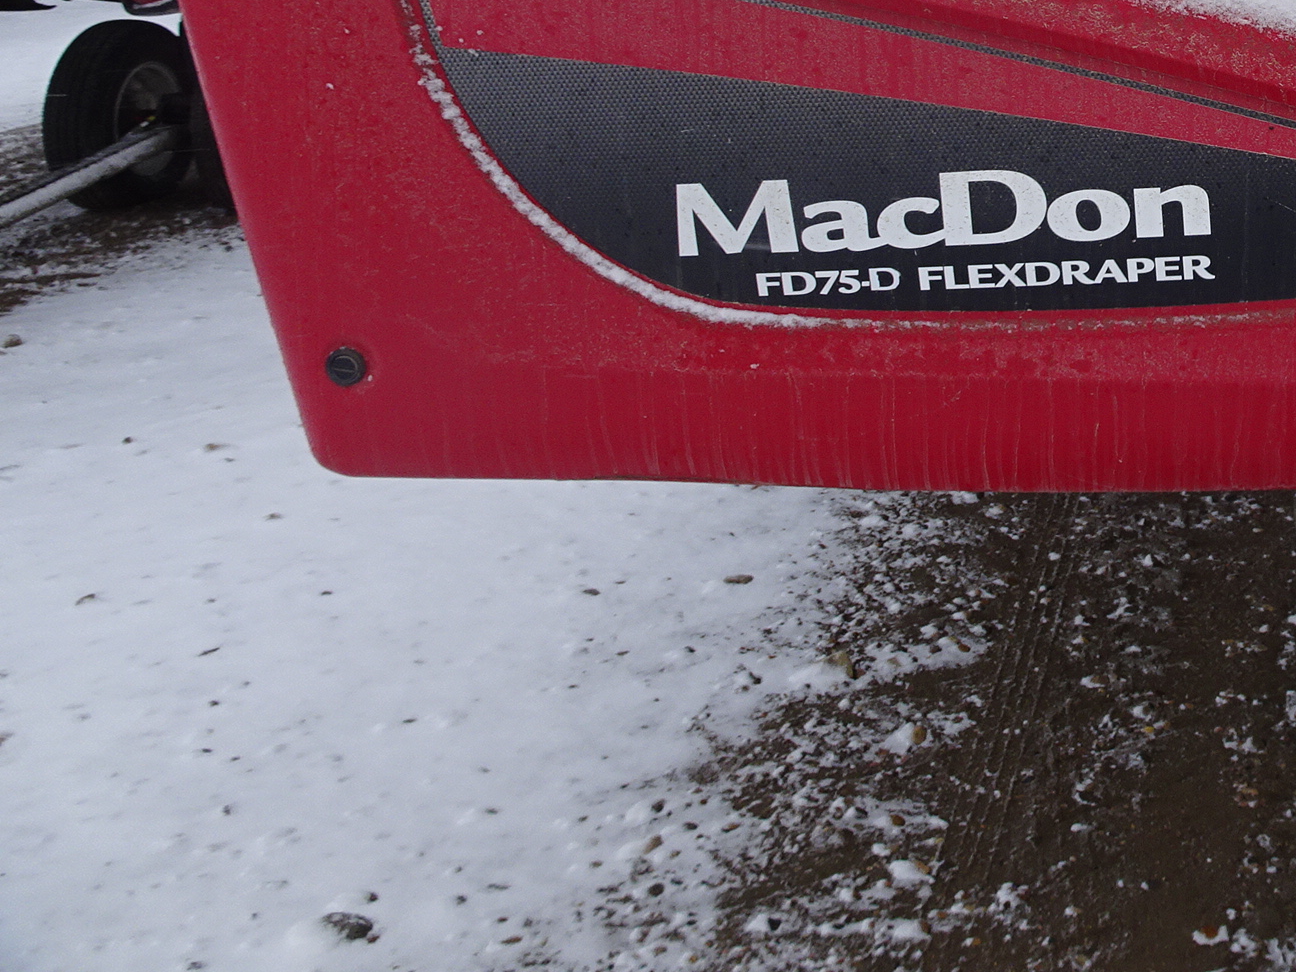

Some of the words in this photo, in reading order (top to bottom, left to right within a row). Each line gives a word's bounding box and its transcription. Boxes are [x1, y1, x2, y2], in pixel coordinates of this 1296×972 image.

[676, 170, 1211, 256] MacDon
[755, 267, 900, 296] FD75-D
[918, 256, 1215, 290] FLEXDRAPER
